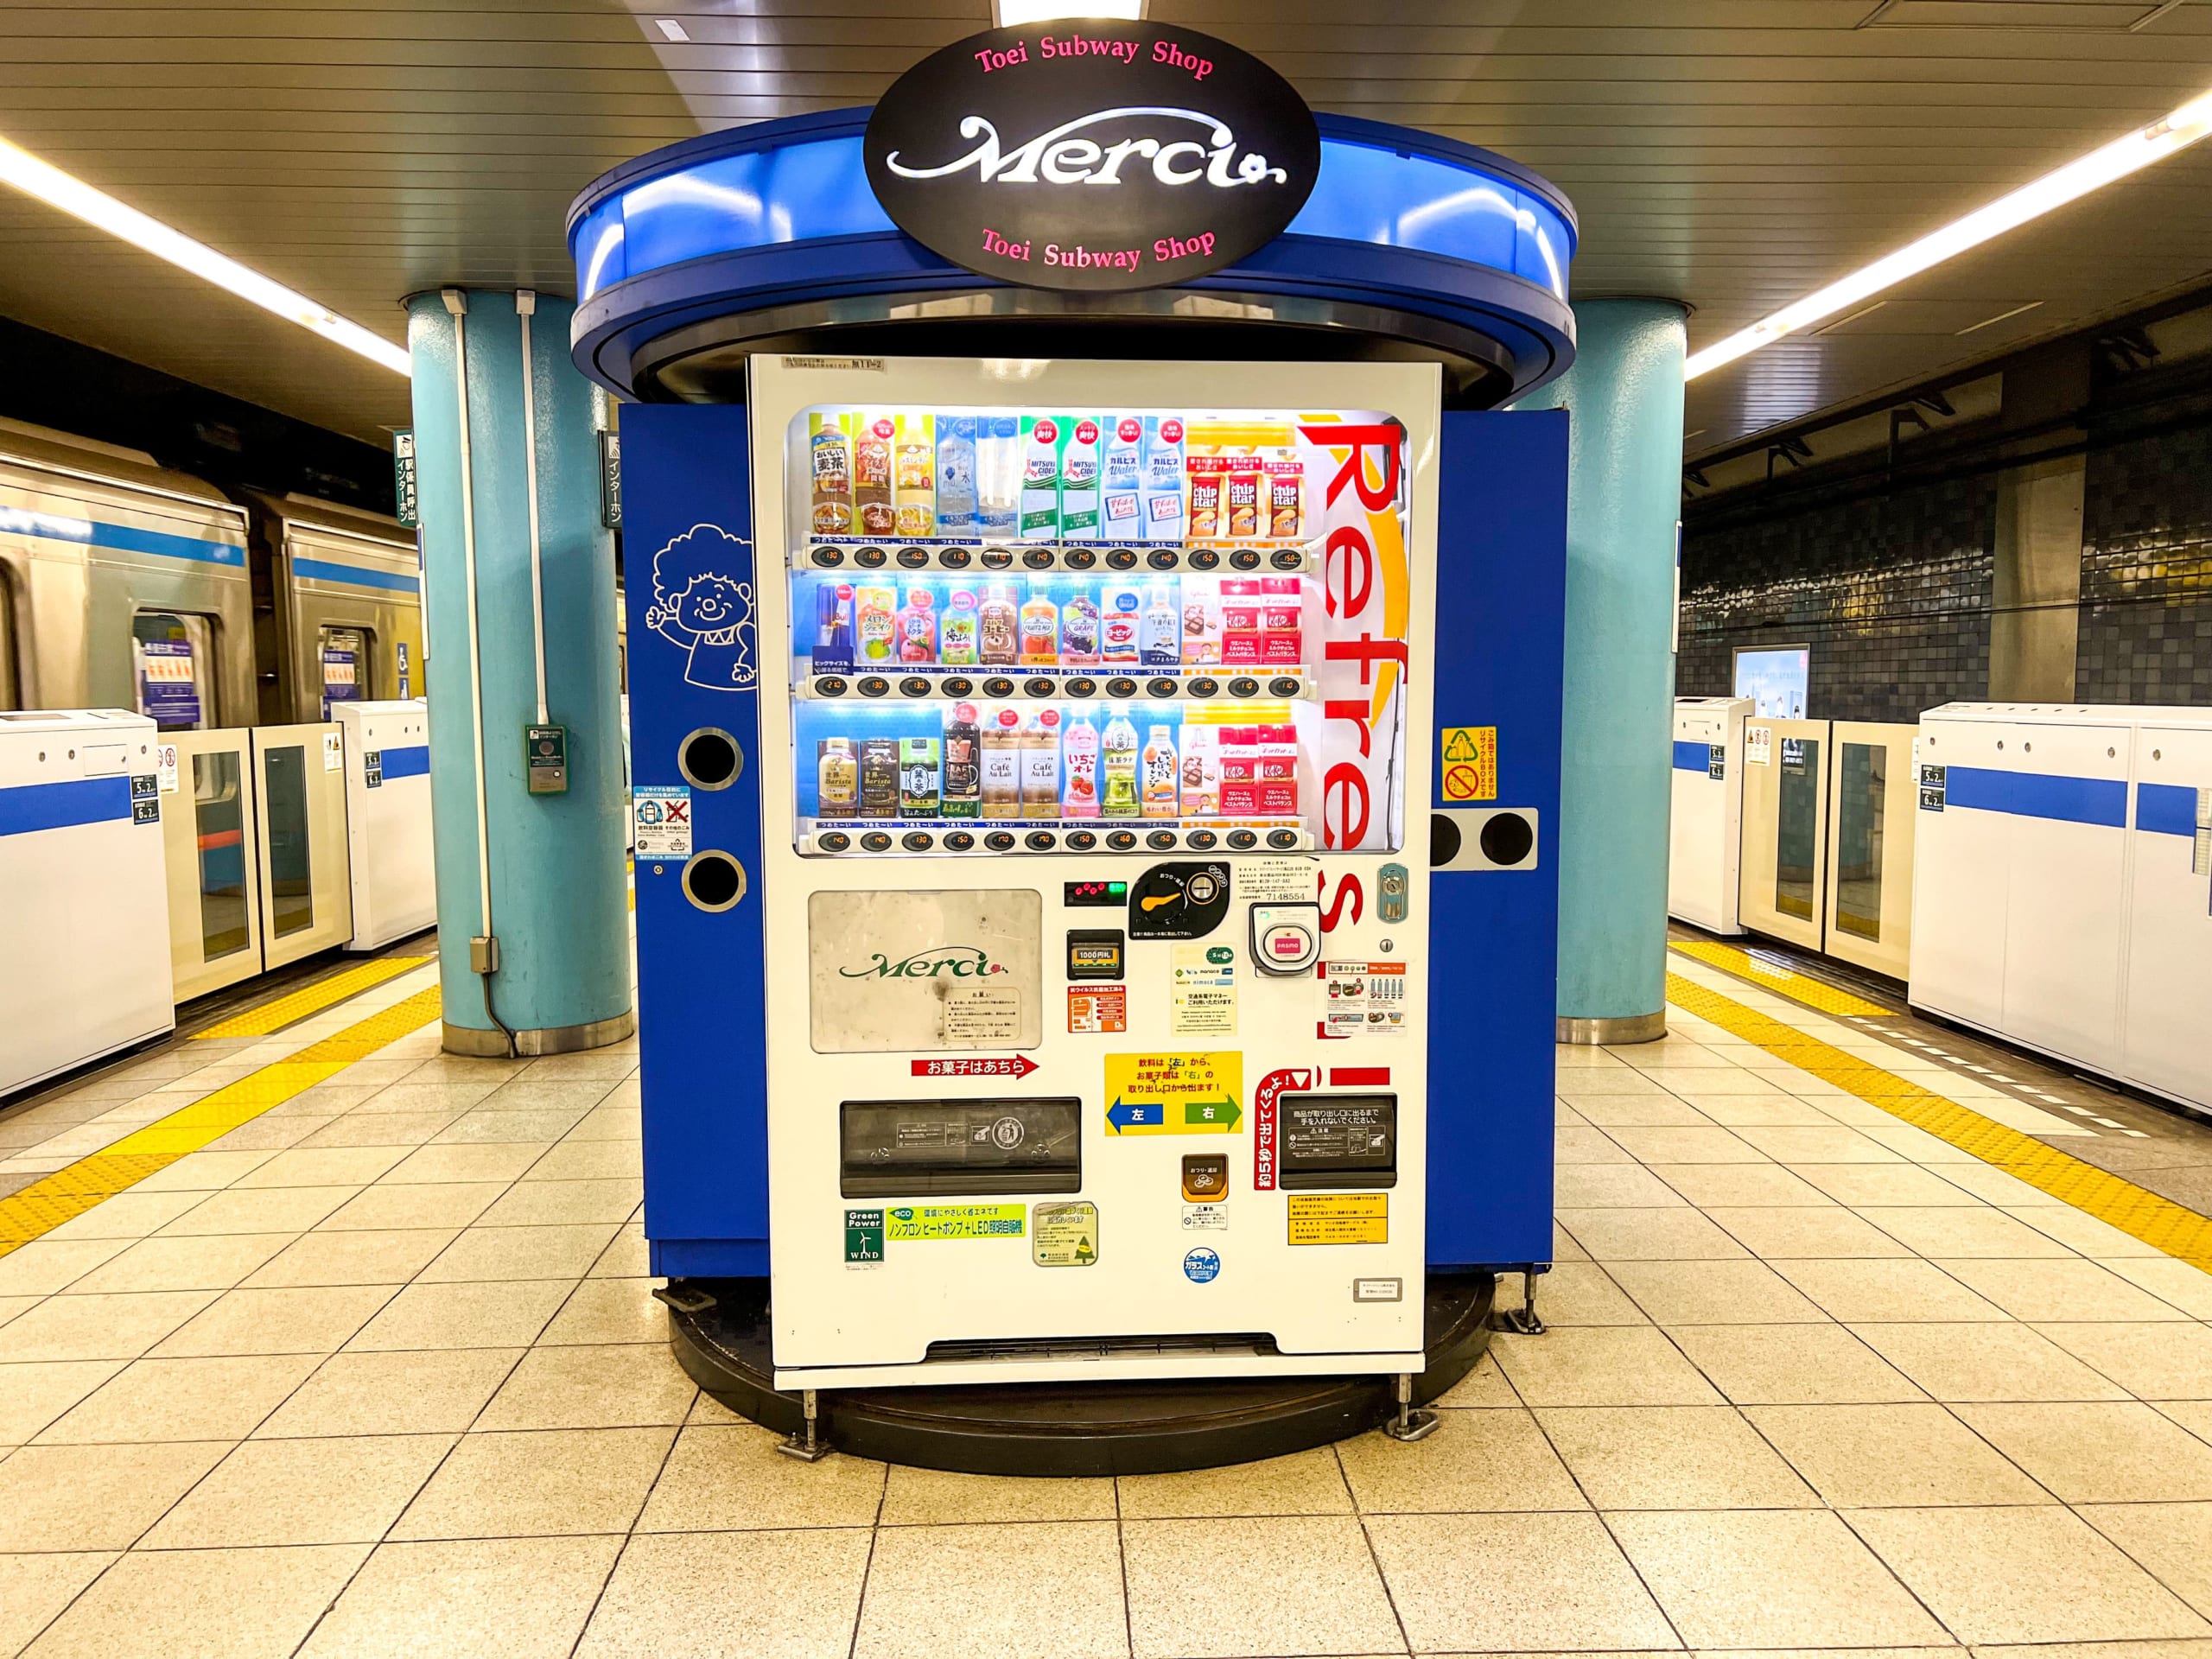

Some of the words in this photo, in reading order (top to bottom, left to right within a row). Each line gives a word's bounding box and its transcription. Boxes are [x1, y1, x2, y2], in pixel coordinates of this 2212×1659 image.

[975, 41, 1029, 74] Toei
[1040, 35, 1140, 64] Subway
[1152, 41, 1214, 81] Shop
[887, 106, 1287, 188] Merci
[982, 228, 1030, 261] Toei
[1044, 244, 1141, 272] Subway
[1154, 229, 1216, 262] Shop
[817, 458, 843, 470] 麦茶
[1109, 466, 1137, 476] Water
[1152, 467, 1179, 476] Water
[398, 460, 407, 522] インターホン
[609, 461, 621, 522] インターホン
[1193, 486, 1217, 498] chip
[1231, 485, 1254, 496] chip
[1273, 485, 1296, 497] chip
[1193, 497, 1217, 508] star
[1231, 495, 1254, 505] star
[1273, 496, 1296, 505] star
[1069, 754, 1096, 765] いちご
[1147, 761, 1160, 787] オレンジ
[839, 946, 1009, 978] Merci
[928, 1060, 1025, 1075] お菓子はあちら
[1132, 1109, 1144, 1121] 左
[1203, 1107, 1215, 1119] 右
[925, 1208, 999, 1217] 環境にやさしく省エネです
